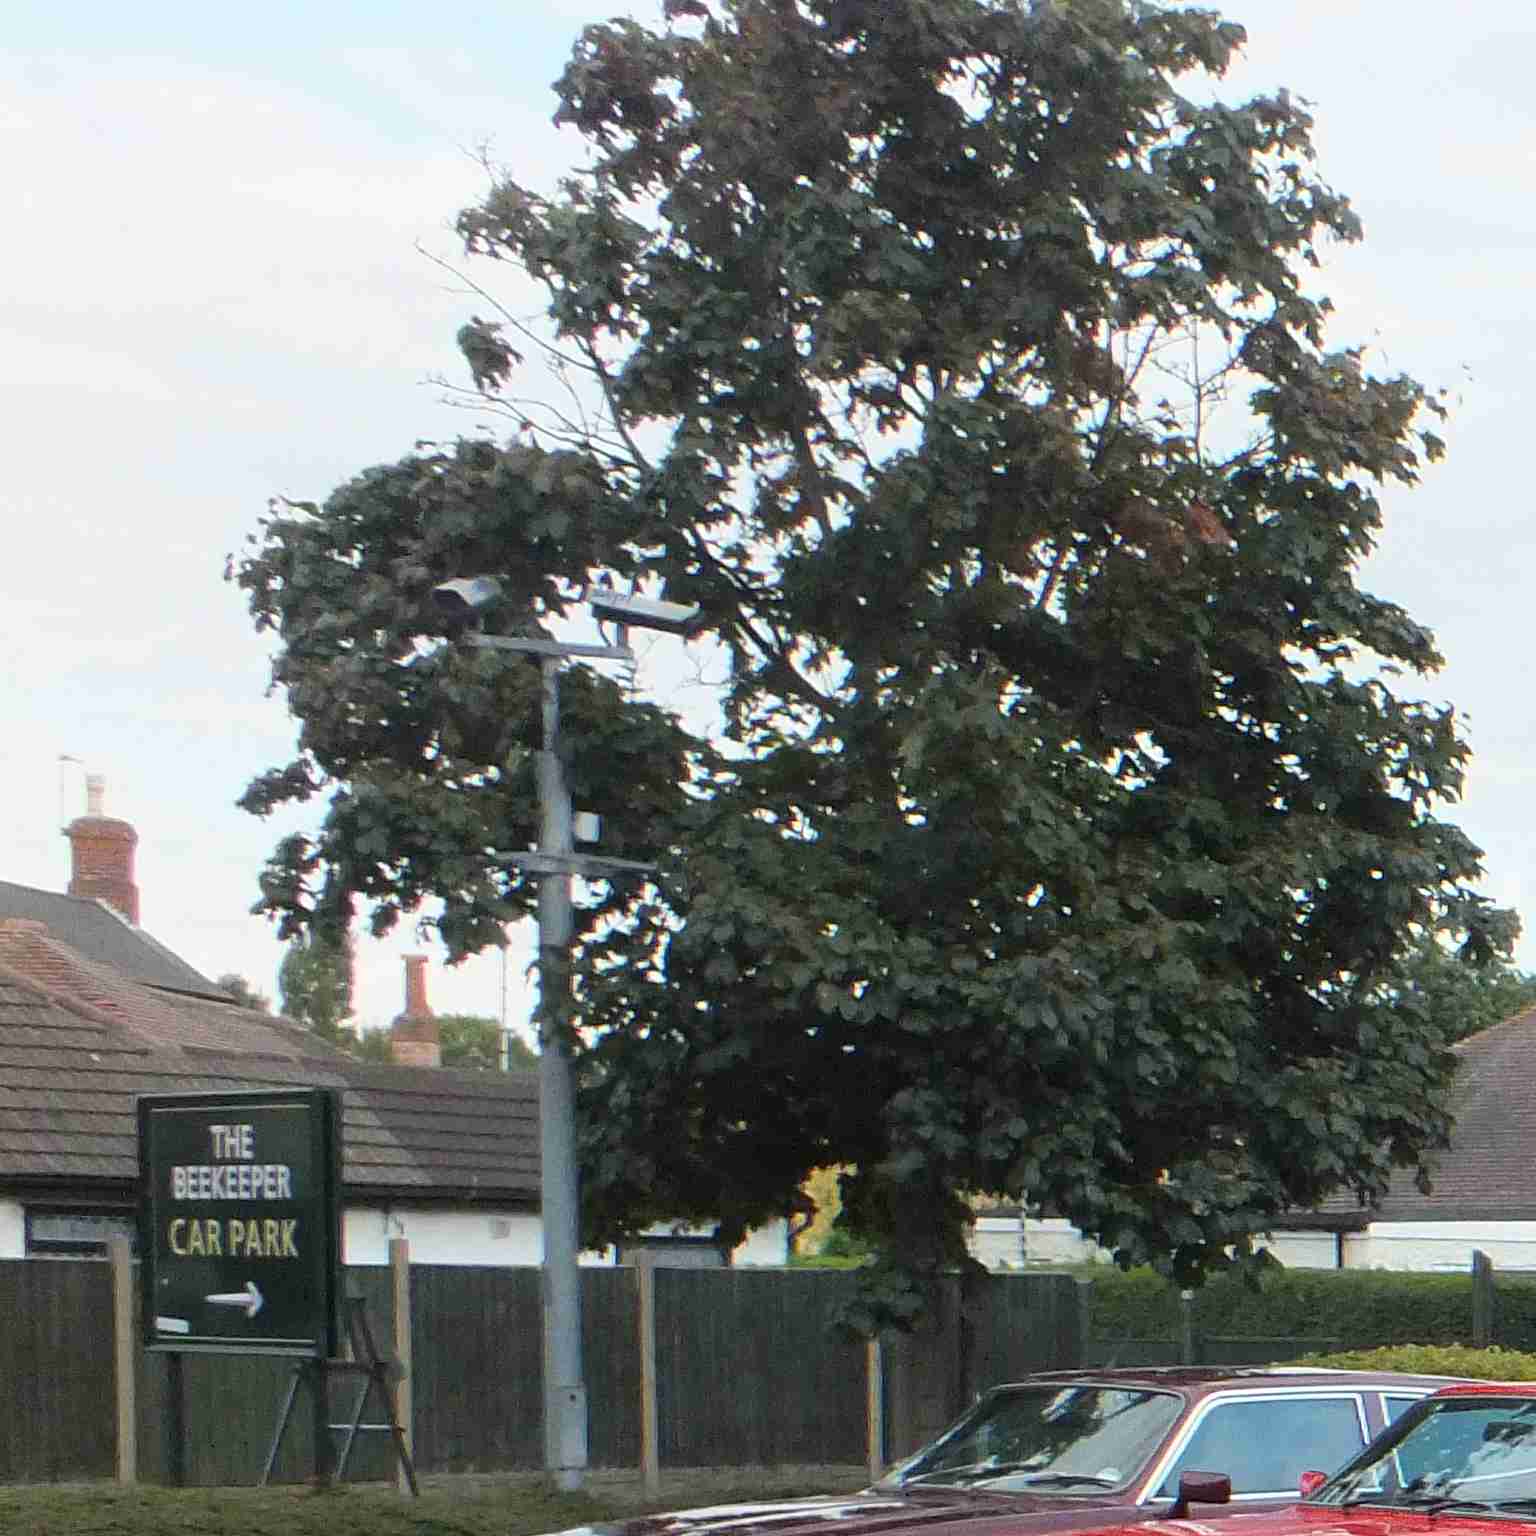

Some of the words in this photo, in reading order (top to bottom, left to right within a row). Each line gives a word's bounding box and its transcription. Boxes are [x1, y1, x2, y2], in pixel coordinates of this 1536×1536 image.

[209, 1125, 254, 1159] THE
[171, 1165, 291, 1200] BEEKEEPER
[168, 1218, 222, 1256] CAR
[228, 1218, 298, 1257] PARK
